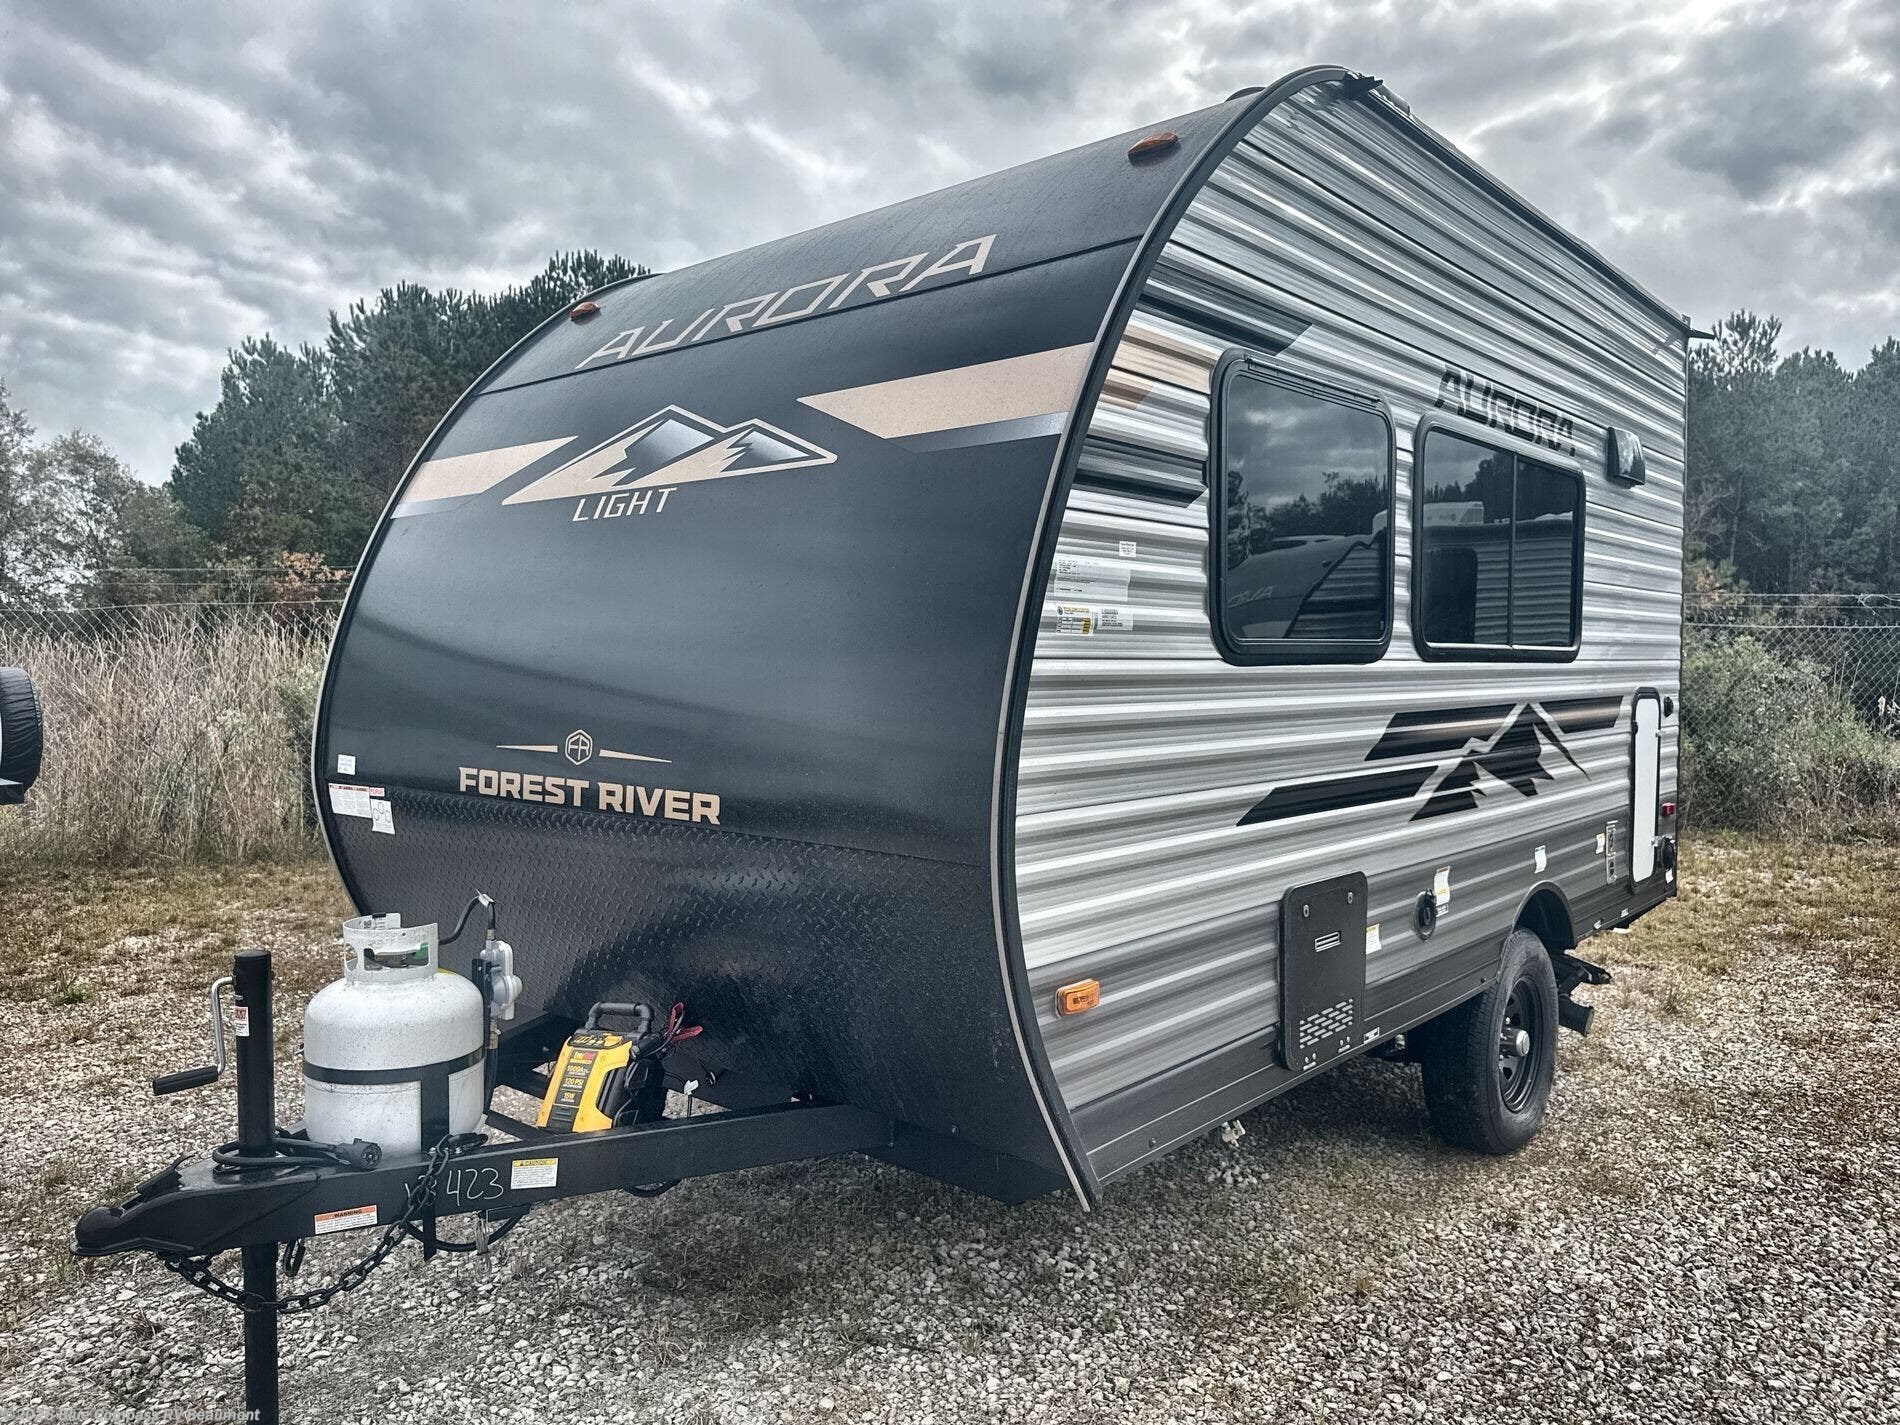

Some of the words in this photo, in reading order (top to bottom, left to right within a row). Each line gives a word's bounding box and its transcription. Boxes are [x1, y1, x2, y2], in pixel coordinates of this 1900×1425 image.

[575, 234, 998, 370] AURORA
[1433, 364, 1577, 457] AURORA
[572, 487, 677, 522] LIGHT
[458, 766, 590, 807] FOREST
[598, 781, 721, 826] RIVER
[525, 1159, 547, 1167] CAUTION
[334, 1208, 363, 1219] WARNING
